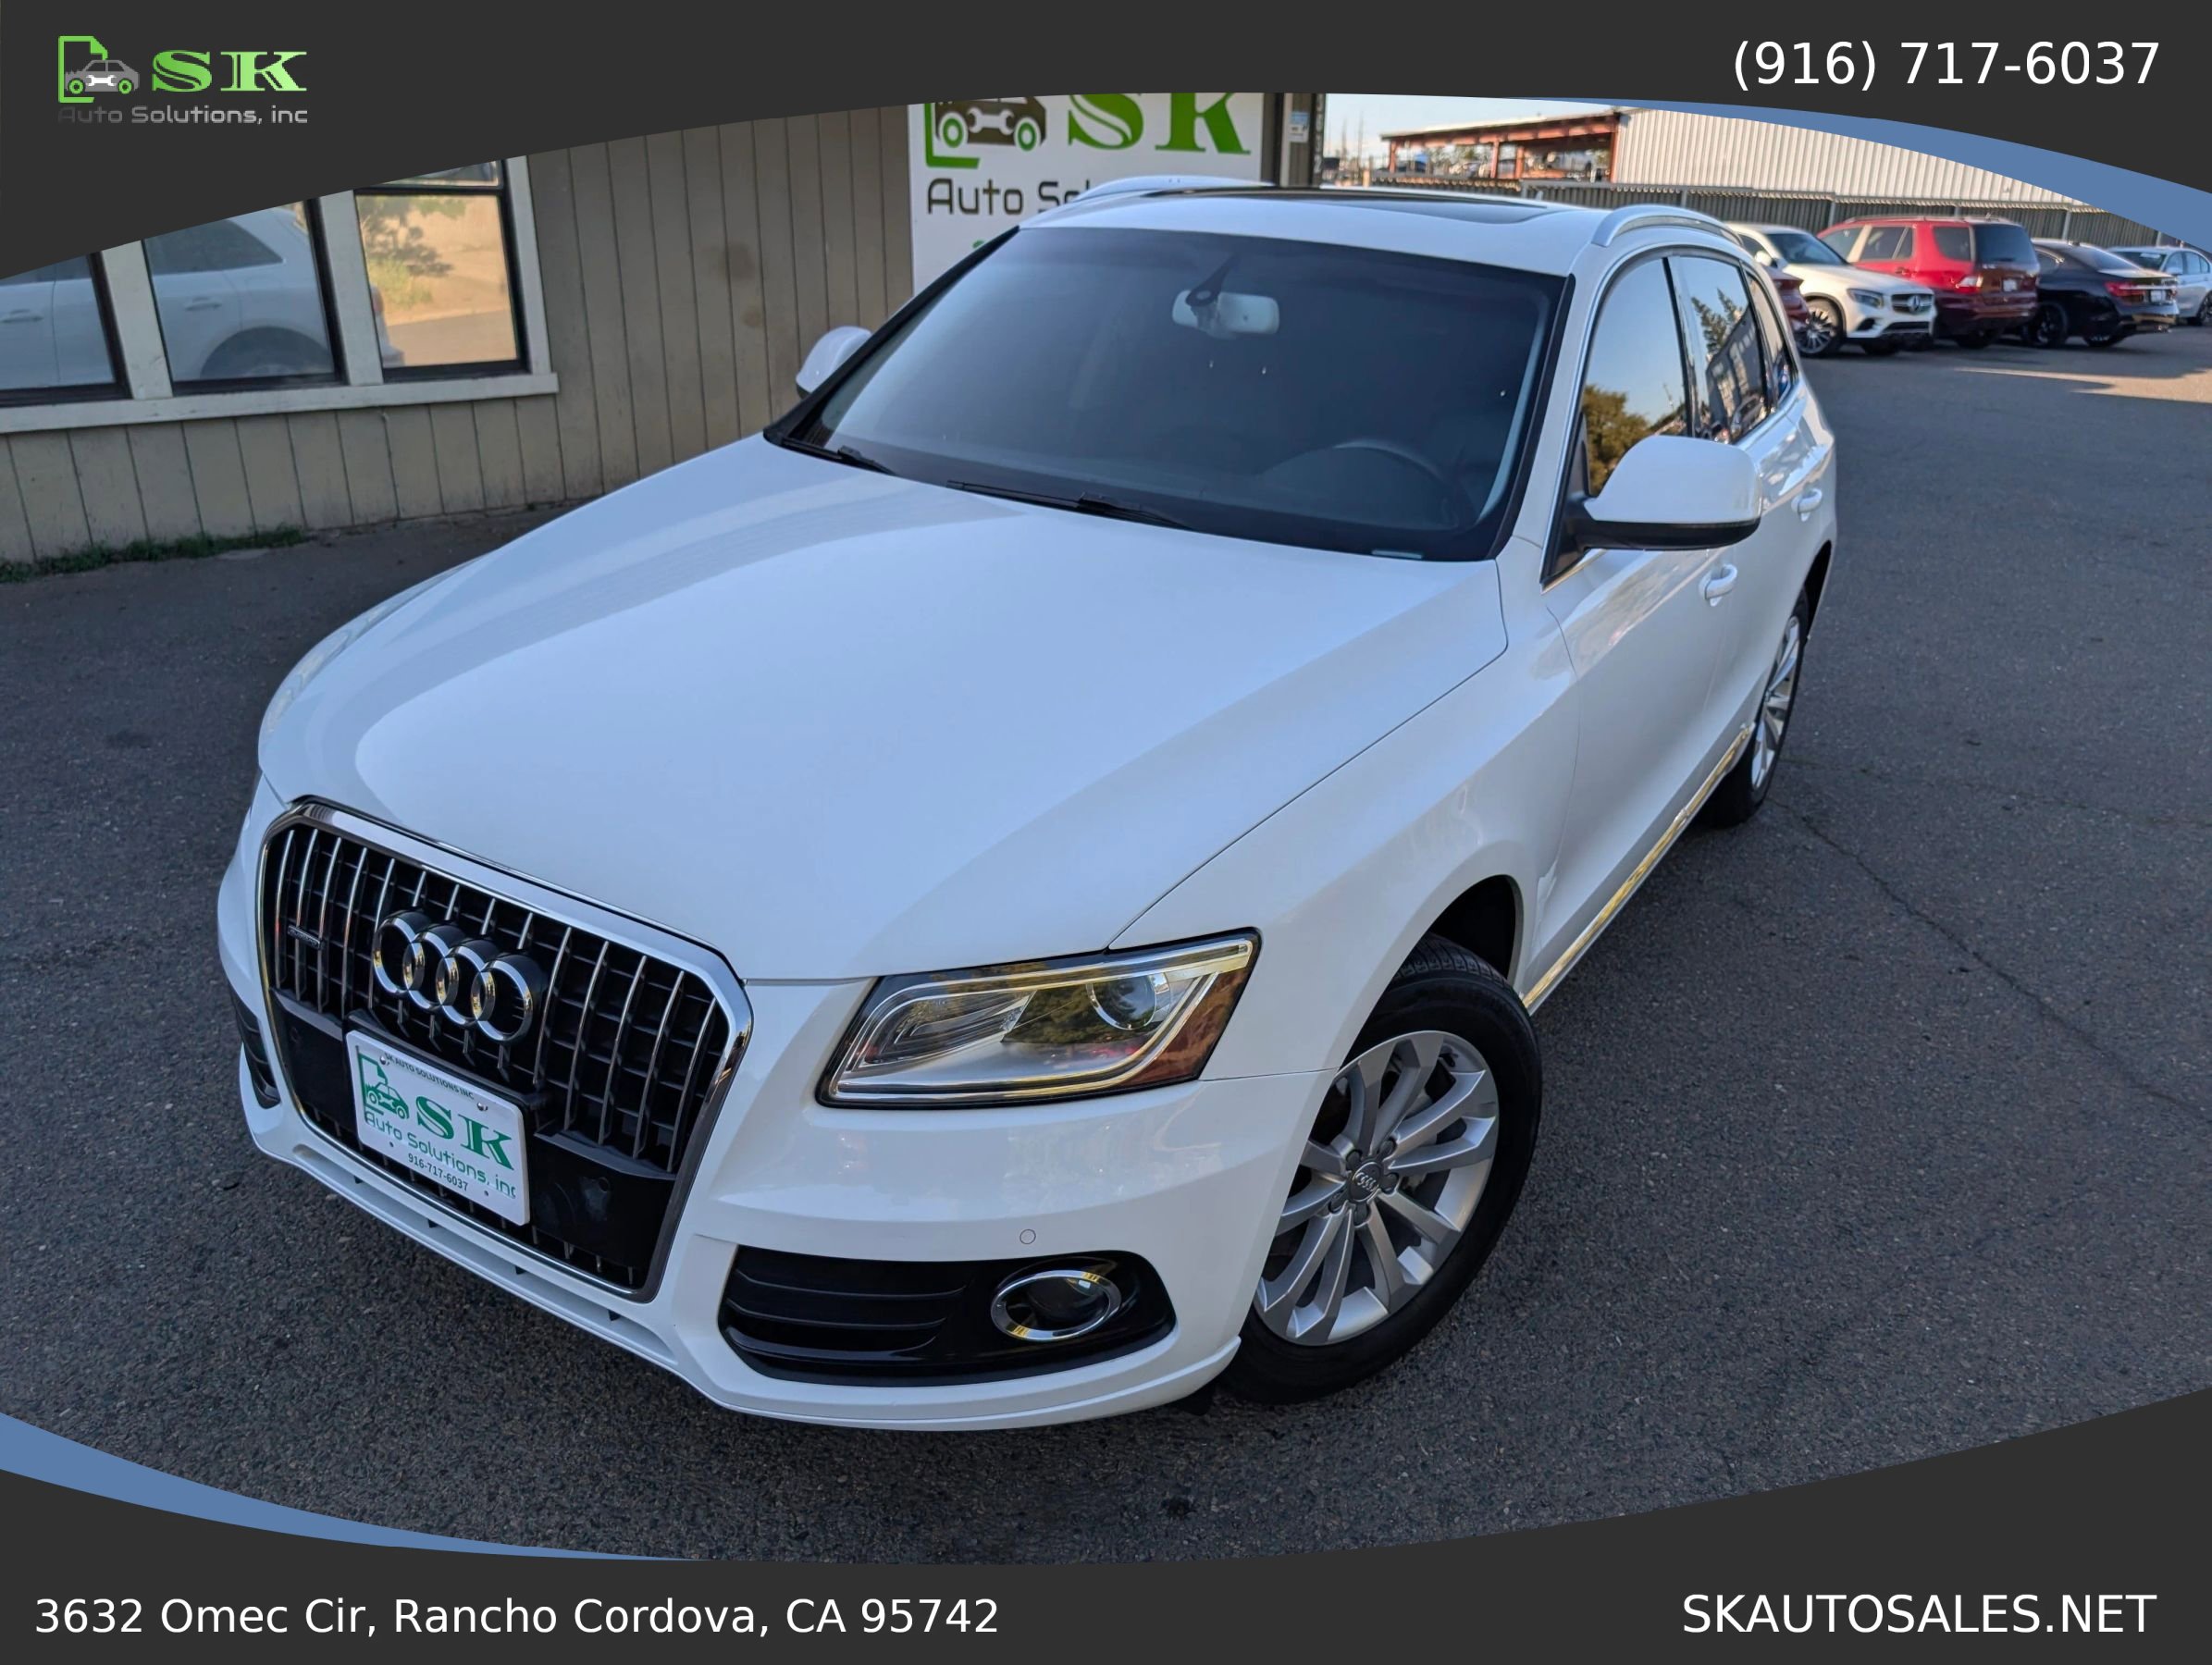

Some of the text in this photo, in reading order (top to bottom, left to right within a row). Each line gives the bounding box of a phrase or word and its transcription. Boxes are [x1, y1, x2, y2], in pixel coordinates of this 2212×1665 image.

[927, 178, 1023, 216] Auto
[365, 1110, 403, 1141] Auto
[407, 1131, 490, 1186] Solutions,
[416, 1096, 514, 1171] SK
[407, 1153, 469, 1192] 916-717-6037
